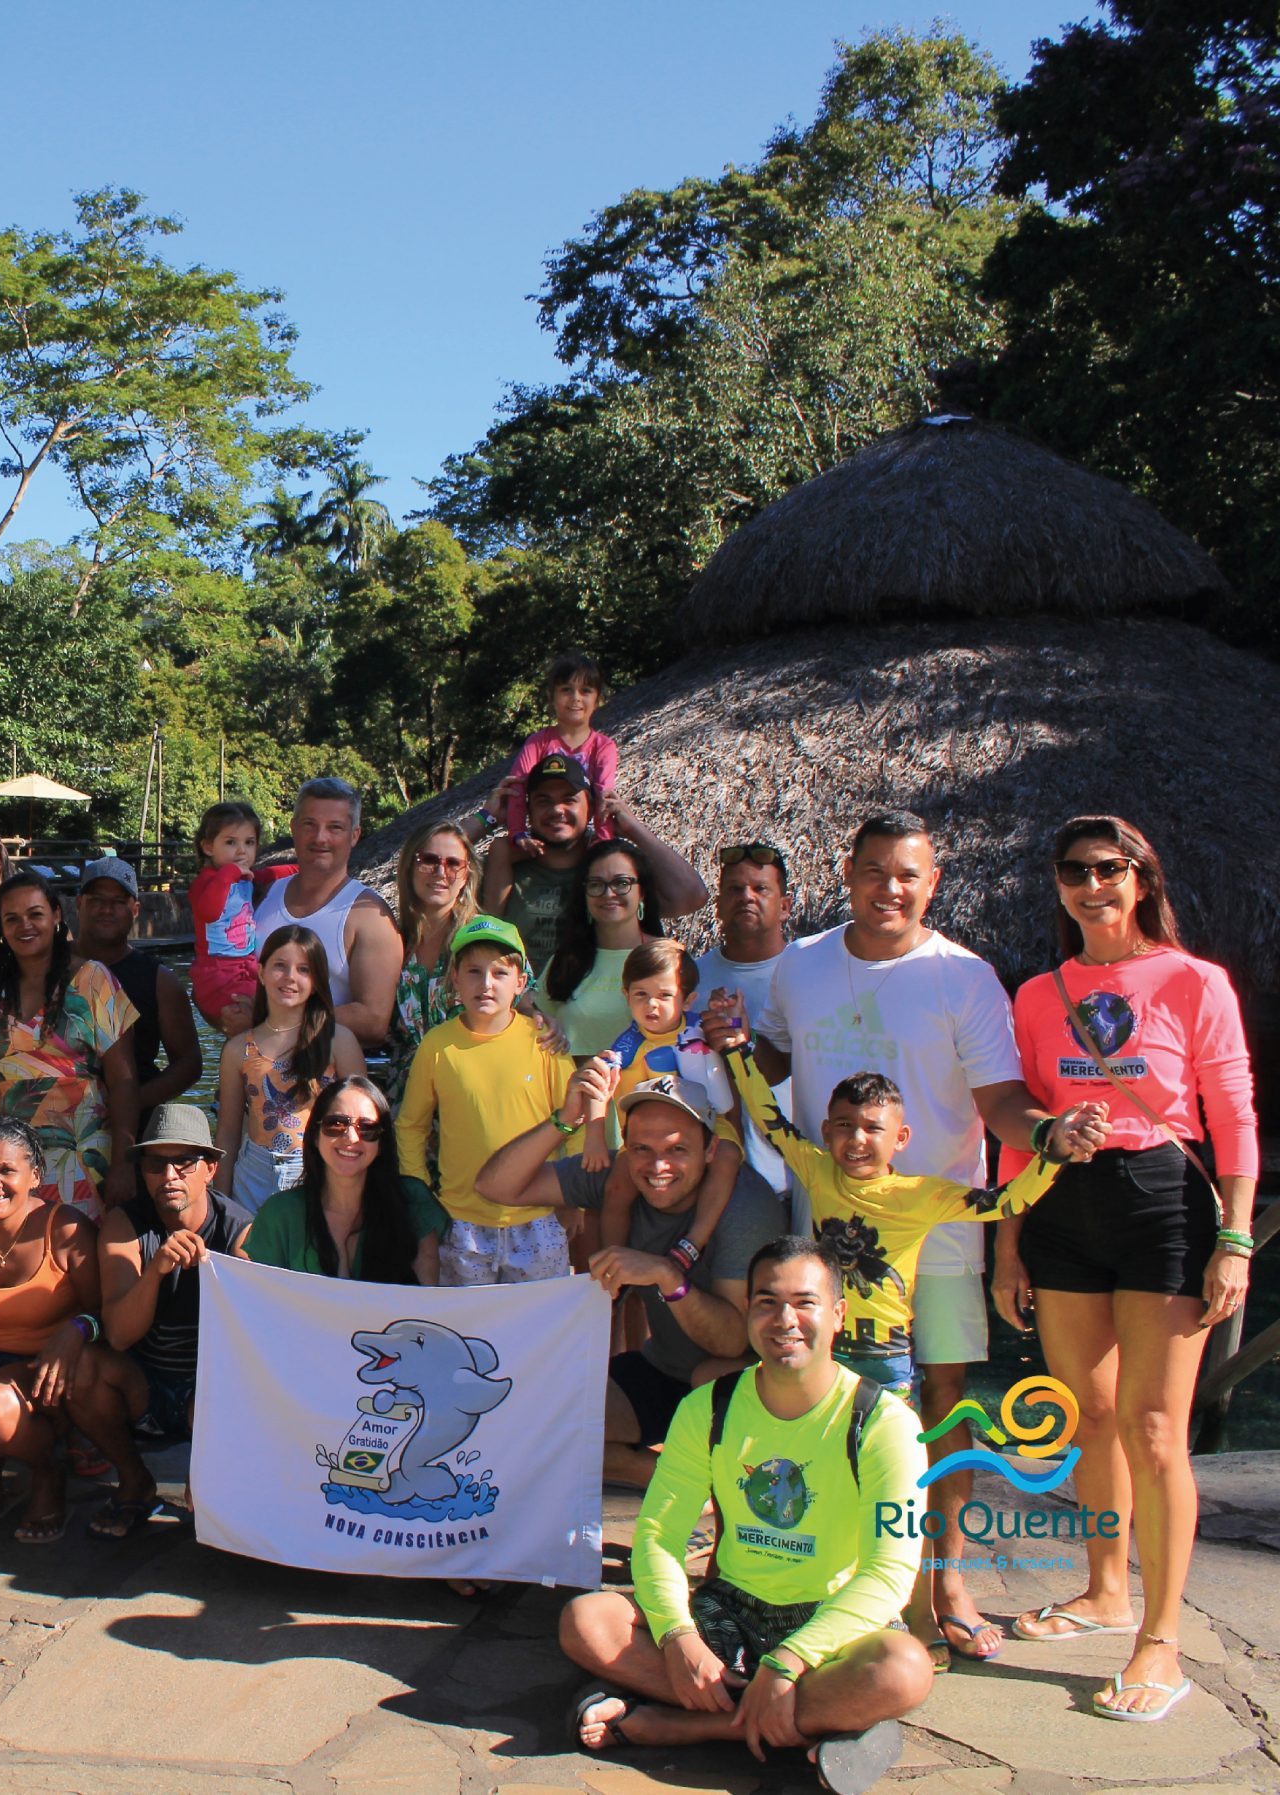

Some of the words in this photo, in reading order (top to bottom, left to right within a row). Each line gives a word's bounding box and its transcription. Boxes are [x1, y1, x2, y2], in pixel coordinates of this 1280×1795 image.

[803, 1029, 898, 1061] adidas
[362, 1420, 398, 1435] Amor
[348, 1434, 389, 1450] Gratidão
[324, 1513, 367, 1540] NOVA
[372, 1526, 490, 1549] CONSCIÊNCIA
[738, 1531, 814, 1554] MERECIMENTO
